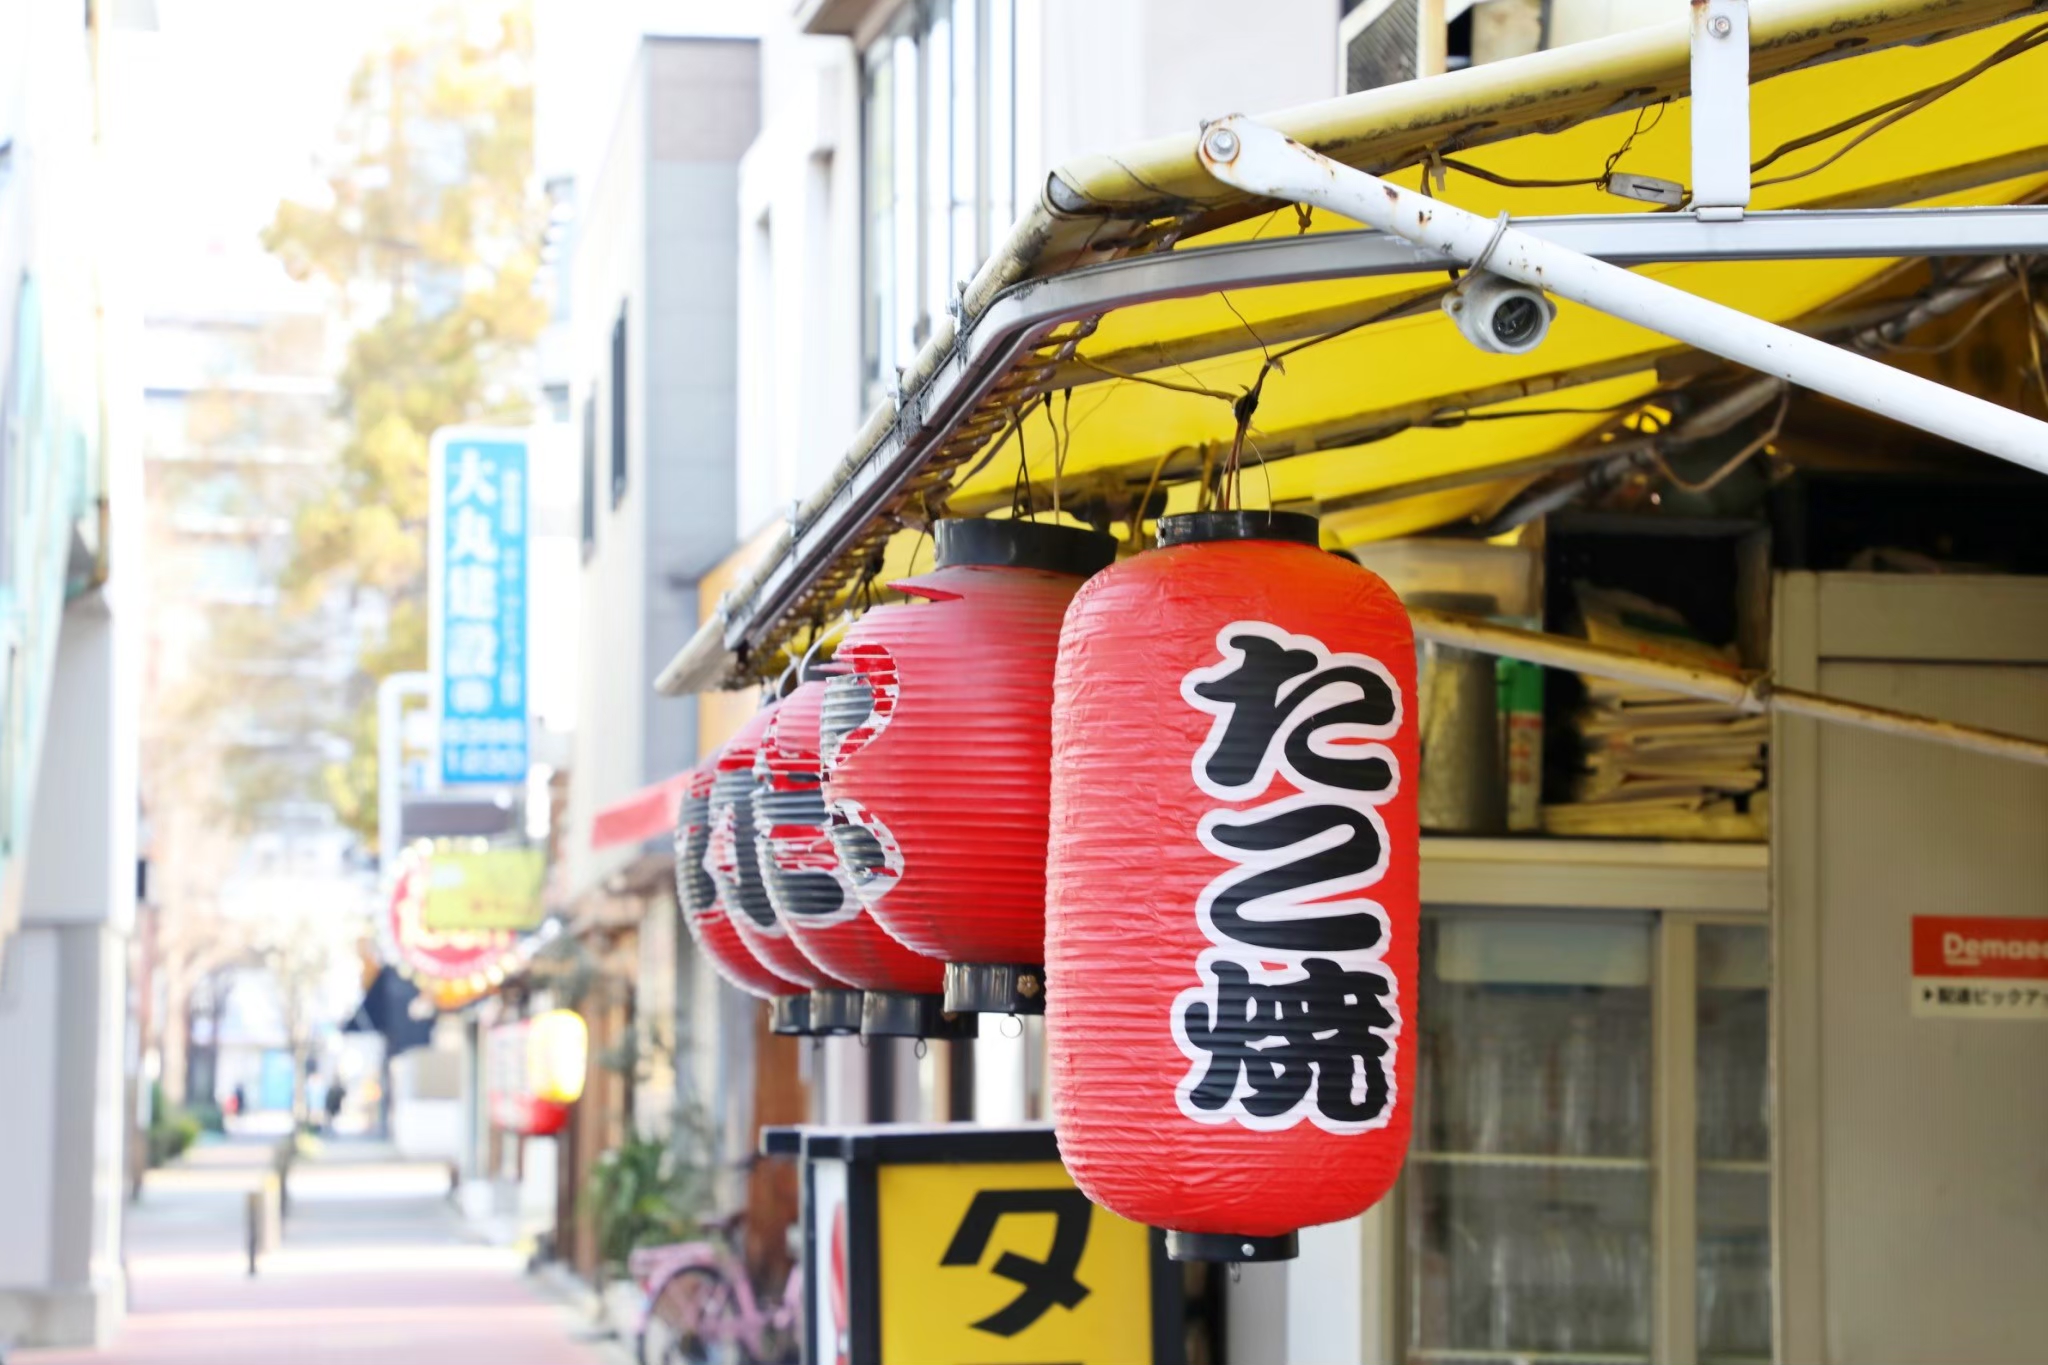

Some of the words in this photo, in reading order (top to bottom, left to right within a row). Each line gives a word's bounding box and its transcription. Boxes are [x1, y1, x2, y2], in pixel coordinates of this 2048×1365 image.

[1181, 632, 1398, 1125] たこ焼
[939, 1188, 1093, 1365] タ
